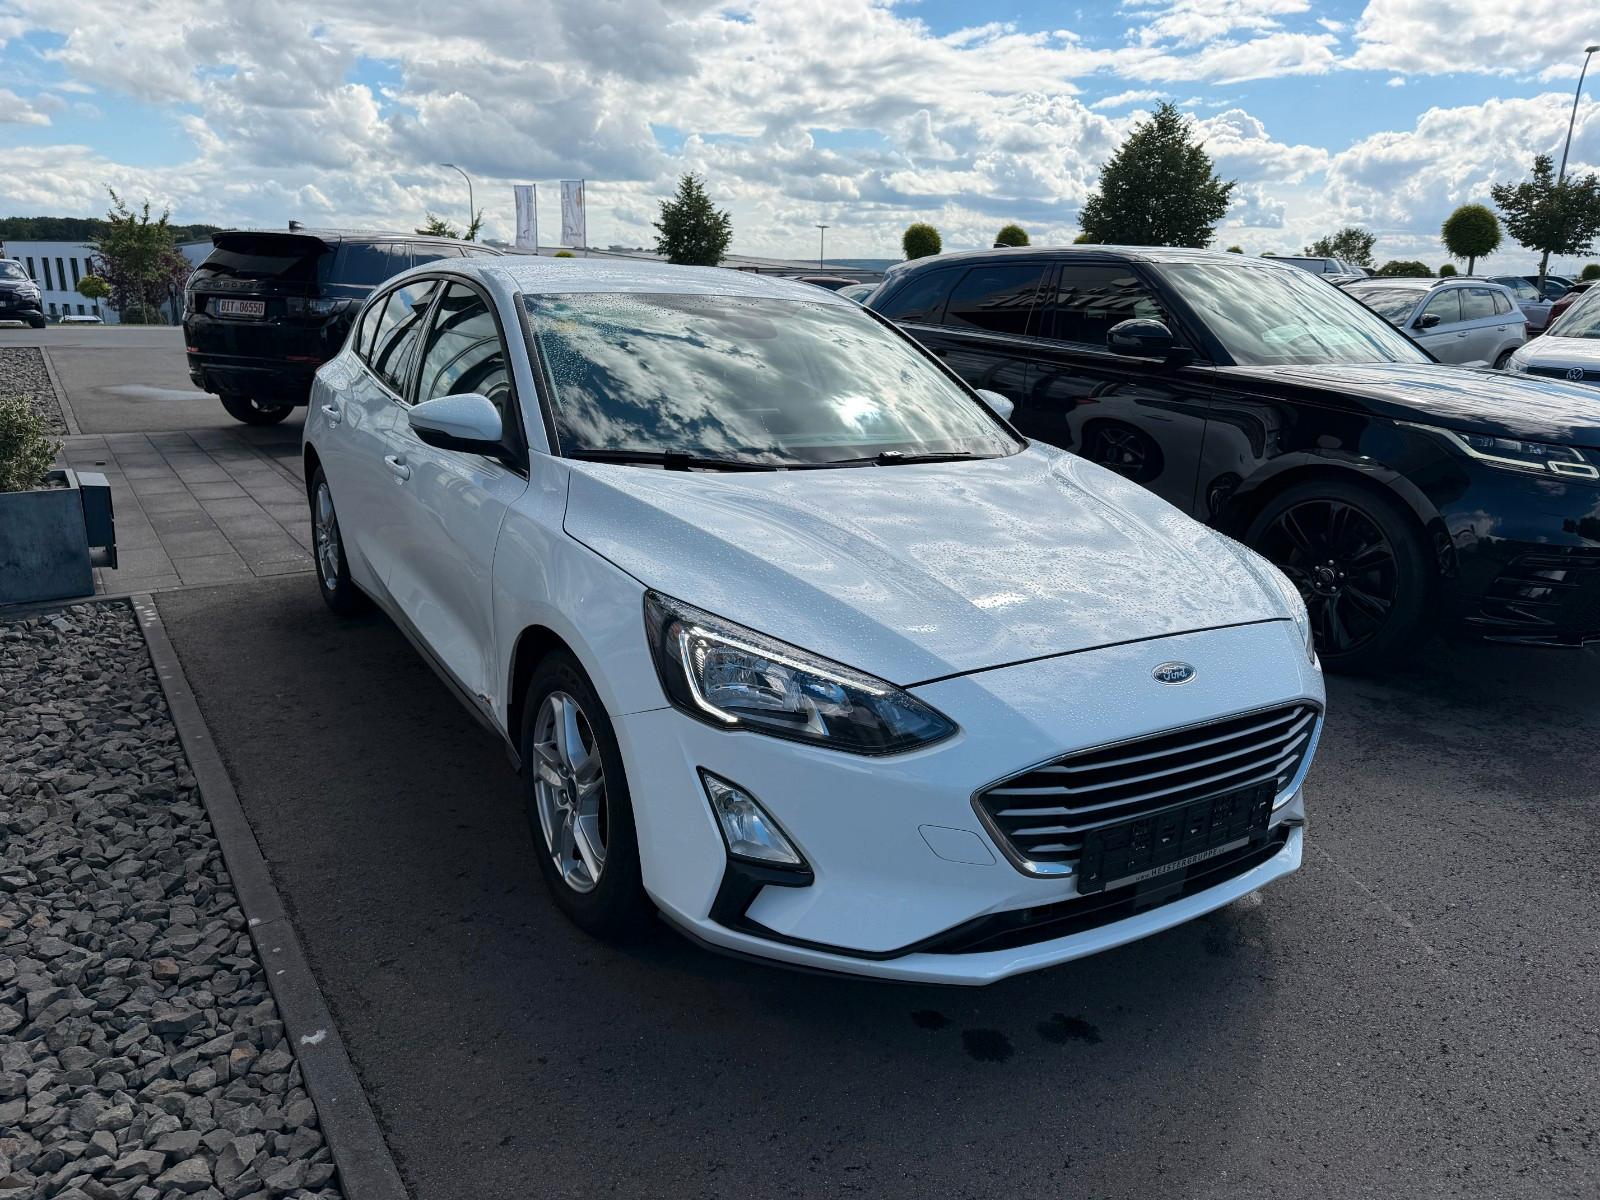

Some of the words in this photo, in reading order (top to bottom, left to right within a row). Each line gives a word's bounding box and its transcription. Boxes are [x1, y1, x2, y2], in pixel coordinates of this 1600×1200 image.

[221, 301, 234, 312] BIT
[240, 302, 263, 313] 06550
[1567, 367, 1584, 381] VW
[1159, 667, 1188, 680] Ford
